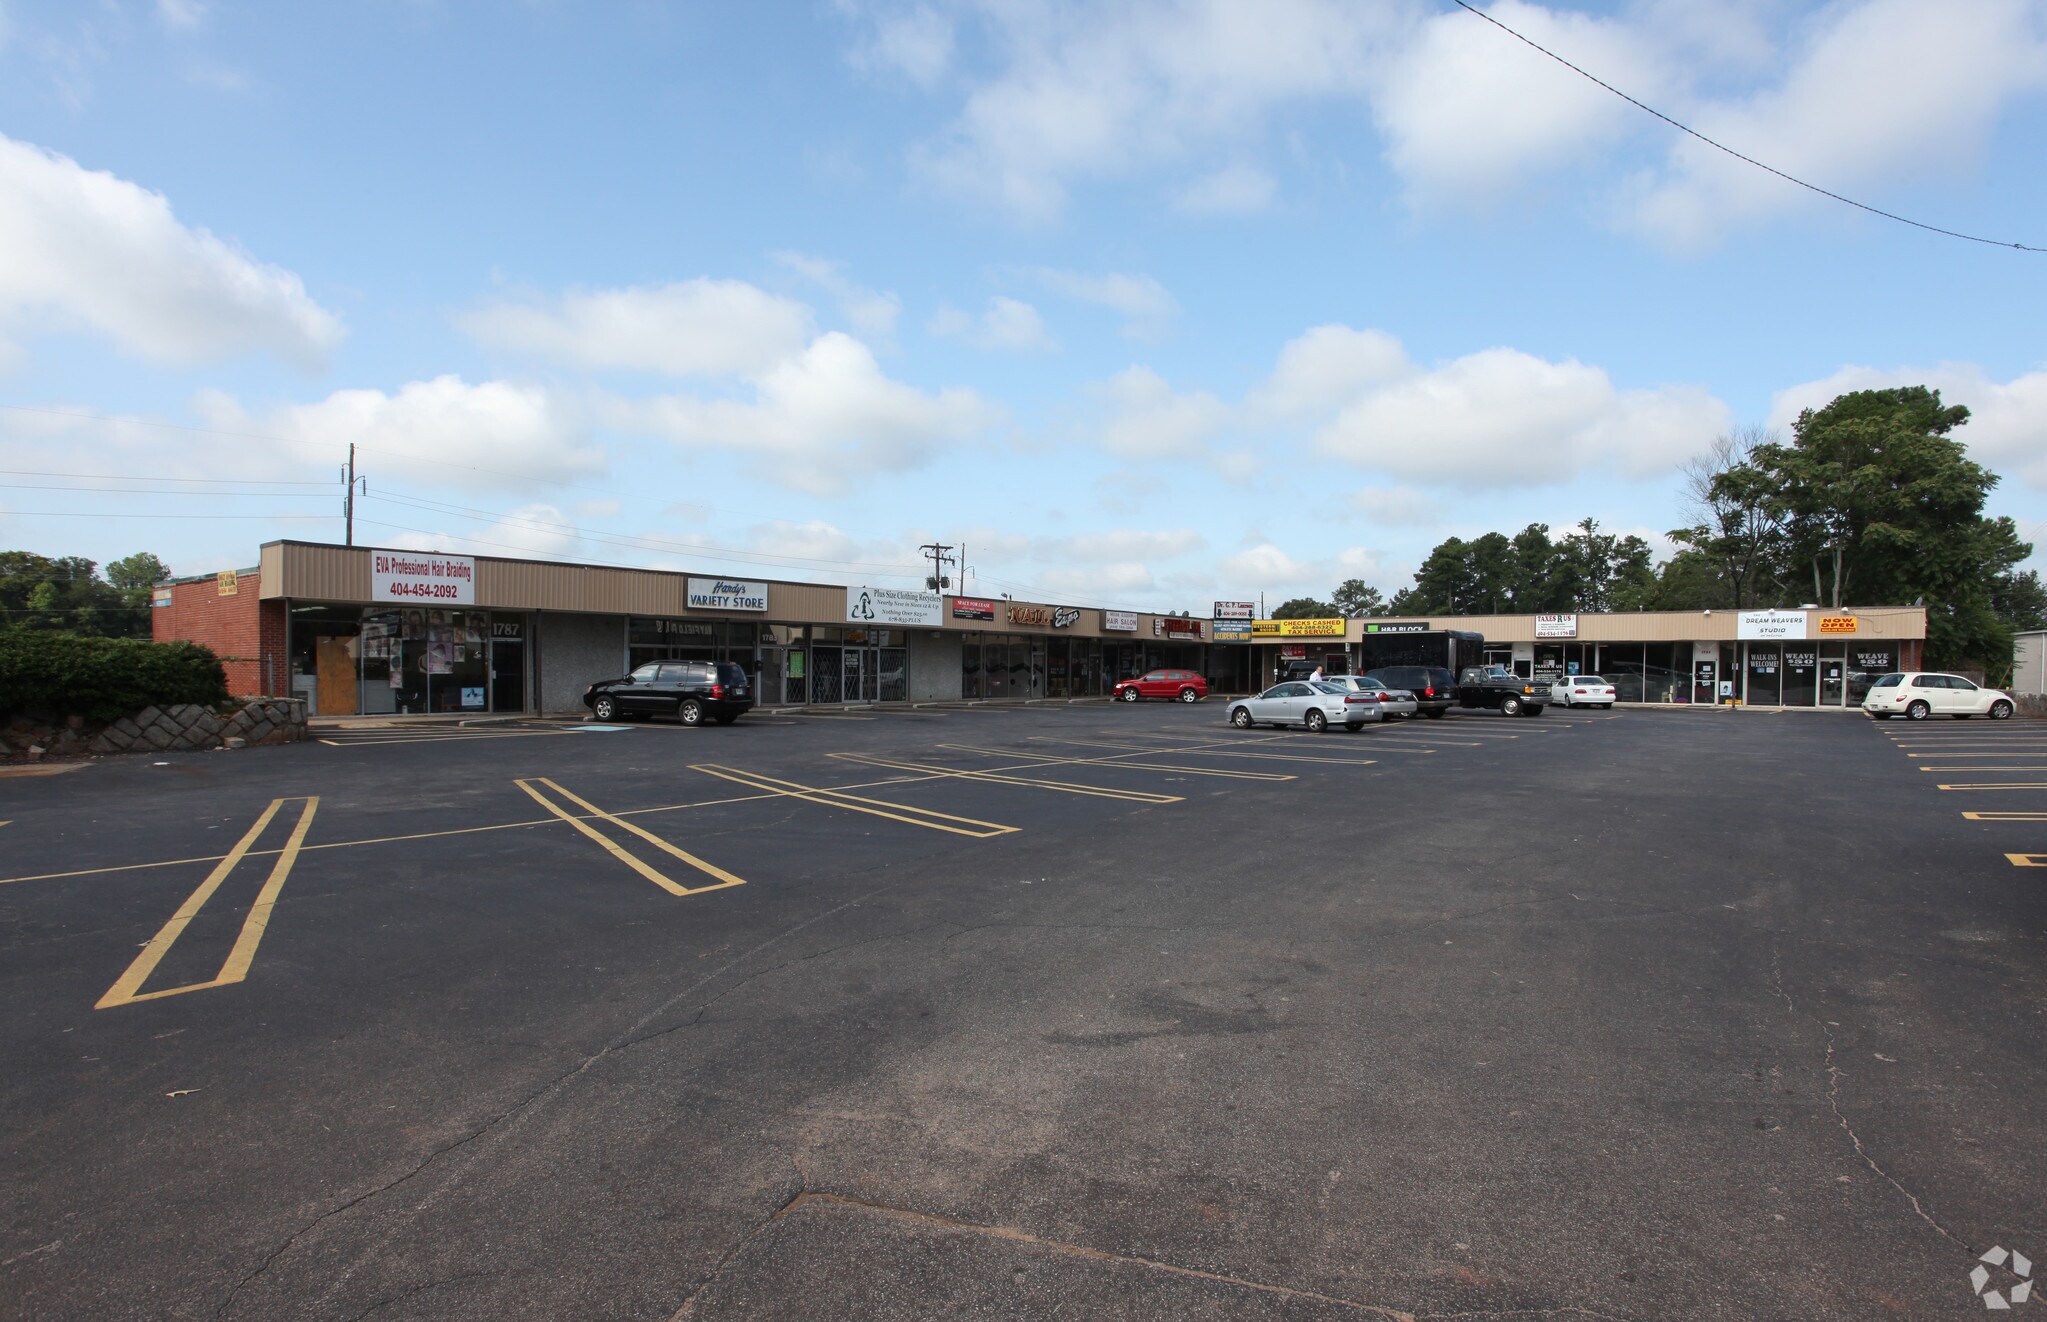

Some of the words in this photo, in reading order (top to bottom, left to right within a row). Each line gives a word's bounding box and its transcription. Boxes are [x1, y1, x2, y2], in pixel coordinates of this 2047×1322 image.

[376, 556, 389, 573] EVA
[391, 557, 430, 576] Professional
[431, 560, 444, 577] Hair
[446, 561, 471, 582] Braiding
[390, 582, 457, 598] 404-454-2092
[712, 581, 746, 596] Hardy's
[874, 589, 885, 598] Plus
[886, 590, 896, 599] Size
[897, 591, 918, 602] Clothing
[919, 593, 941, 603] Recyclers
[690, 594, 729, 607] VARIETY
[733, 597, 764, 609] STORE
[1009, 606, 1051, 625] NAIL
[1054, 606, 1080, 628] Expo
[1107, 617, 1119, 625] HAIR
[1120, 618, 1137, 626] SALON
[492, 623, 519, 636] 1787
